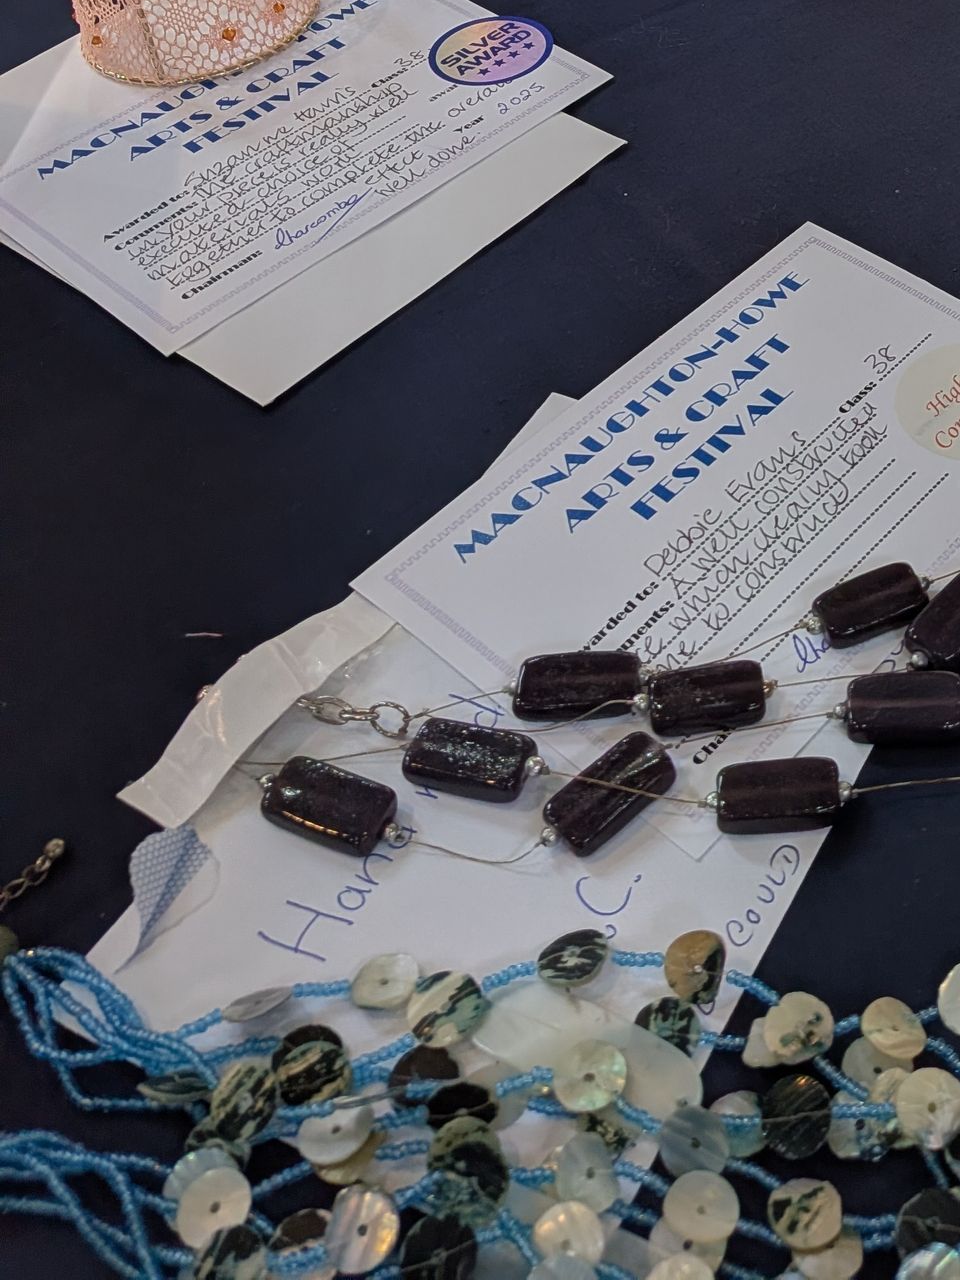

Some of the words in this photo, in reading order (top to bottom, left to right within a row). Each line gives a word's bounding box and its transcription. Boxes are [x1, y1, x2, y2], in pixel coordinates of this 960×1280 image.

[440, 22, 520, 67] SILVER
[456, 30, 531, 76] AWARD
[131, 110, 213, 161] ARTS
[216, 95, 244, 111] &
[246, 36, 346, 94] CRAFT
[182, 71, 339, 153] FESTIVAL
[453, 114, 485, 133] Year
[498, 82, 545, 115] 2025
[104, 199, 169, 242] Awarded
[169, 189, 190, 203] to:
[114, 201, 199, 251] Comments:
[181, 248, 264, 300] Chairman:
[864, 344, 896, 374] 38
[454, 271, 810, 564] MACNAUGHTON-HOWE
[839, 381, 877, 413] Class:
[565, 450, 655, 533] ARTS
[654, 427, 689, 450] &
[685, 333, 790, 422] CRAFT
[630, 388, 794, 520] FESTIVAL
[644, 508, 723, 576] Debbie
[725, 431, 808, 503] Evans
[671, 576, 694, 599] A
[692, 519, 749, 570] well
[582, 601, 637, 652] arded
[636, 581, 660, 601] to:
[702, 603, 730, 632] to
